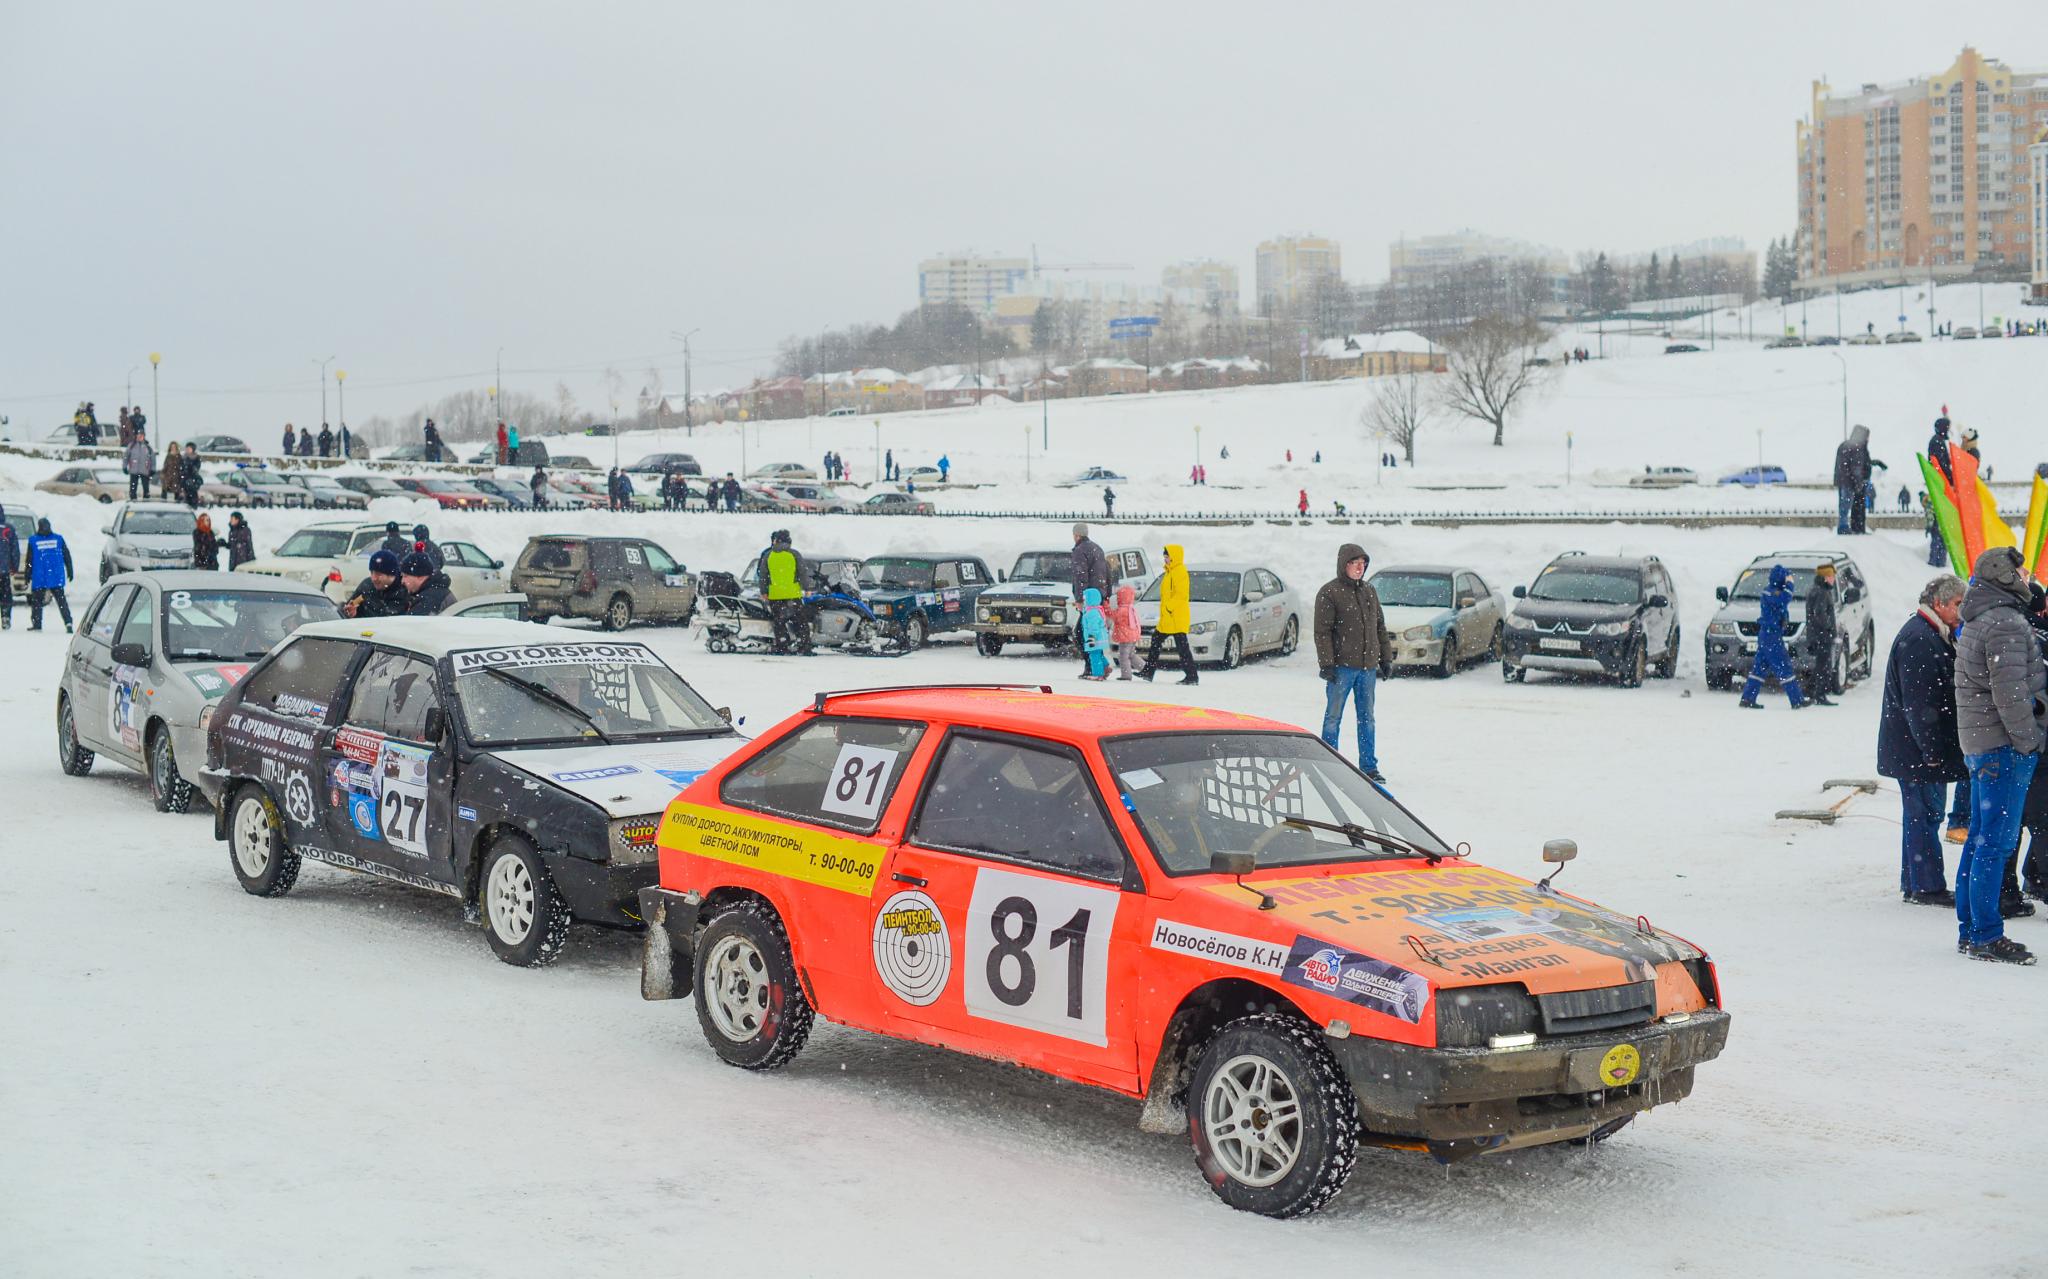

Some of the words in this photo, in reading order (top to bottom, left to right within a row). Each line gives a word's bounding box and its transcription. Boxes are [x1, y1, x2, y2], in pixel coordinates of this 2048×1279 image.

[627, 550, 641, 563] 53
[1127, 554, 1137, 568] 52
[963, 565, 975, 578] 34
[170, 590, 192, 610] 8
[461, 645, 645, 667] MOTORSPORT
[520, 657, 568, 667] RACING
[113, 684, 123, 734] 8
[276, 693, 314, 715] BOGDANOV
[228, 713, 243, 730] СТК
[242, 717, 281, 739] «ТРУДОВЫЕ
[558, 767, 634, 781] AIMOL
[835, 755, 886, 806] 81
[385, 790, 425, 842] 27
[624, 826, 653, 838] AUTO
[671, 812, 698, 827] КУПЛЮ
[698, 817, 731, 835] ДОРОГО
[731, 825, 803, 854] АККУМУЛЯТОРЫ,
[699, 832, 739, 853] ЦВЕТНОЙ
[739, 844, 760, 858] ЛОМ
[299, 846, 392, 877] MOTORSPORT
[809, 853, 817, 866] т.
[821, 853, 875, 879] 90-00-09
[883, 908, 933, 929] ПЕЙНТБОЛ
[902, 920, 941, 936] т.90-00-09
[986, 896, 1091, 1021] 81
[1155, 925, 1248, 961] Новосёлов
[1251, 946, 1284, 970] К.Н.
[1303, 959, 1328, 973] АВТО
[1306, 968, 1338, 986] РАДИО
[1460, 953, 1569, 979] -Мангал
[1341, 978, 1371, 992] ТОЛЬКО
[1343, 967, 1407, 992] ДВИЖЕНИЕ
